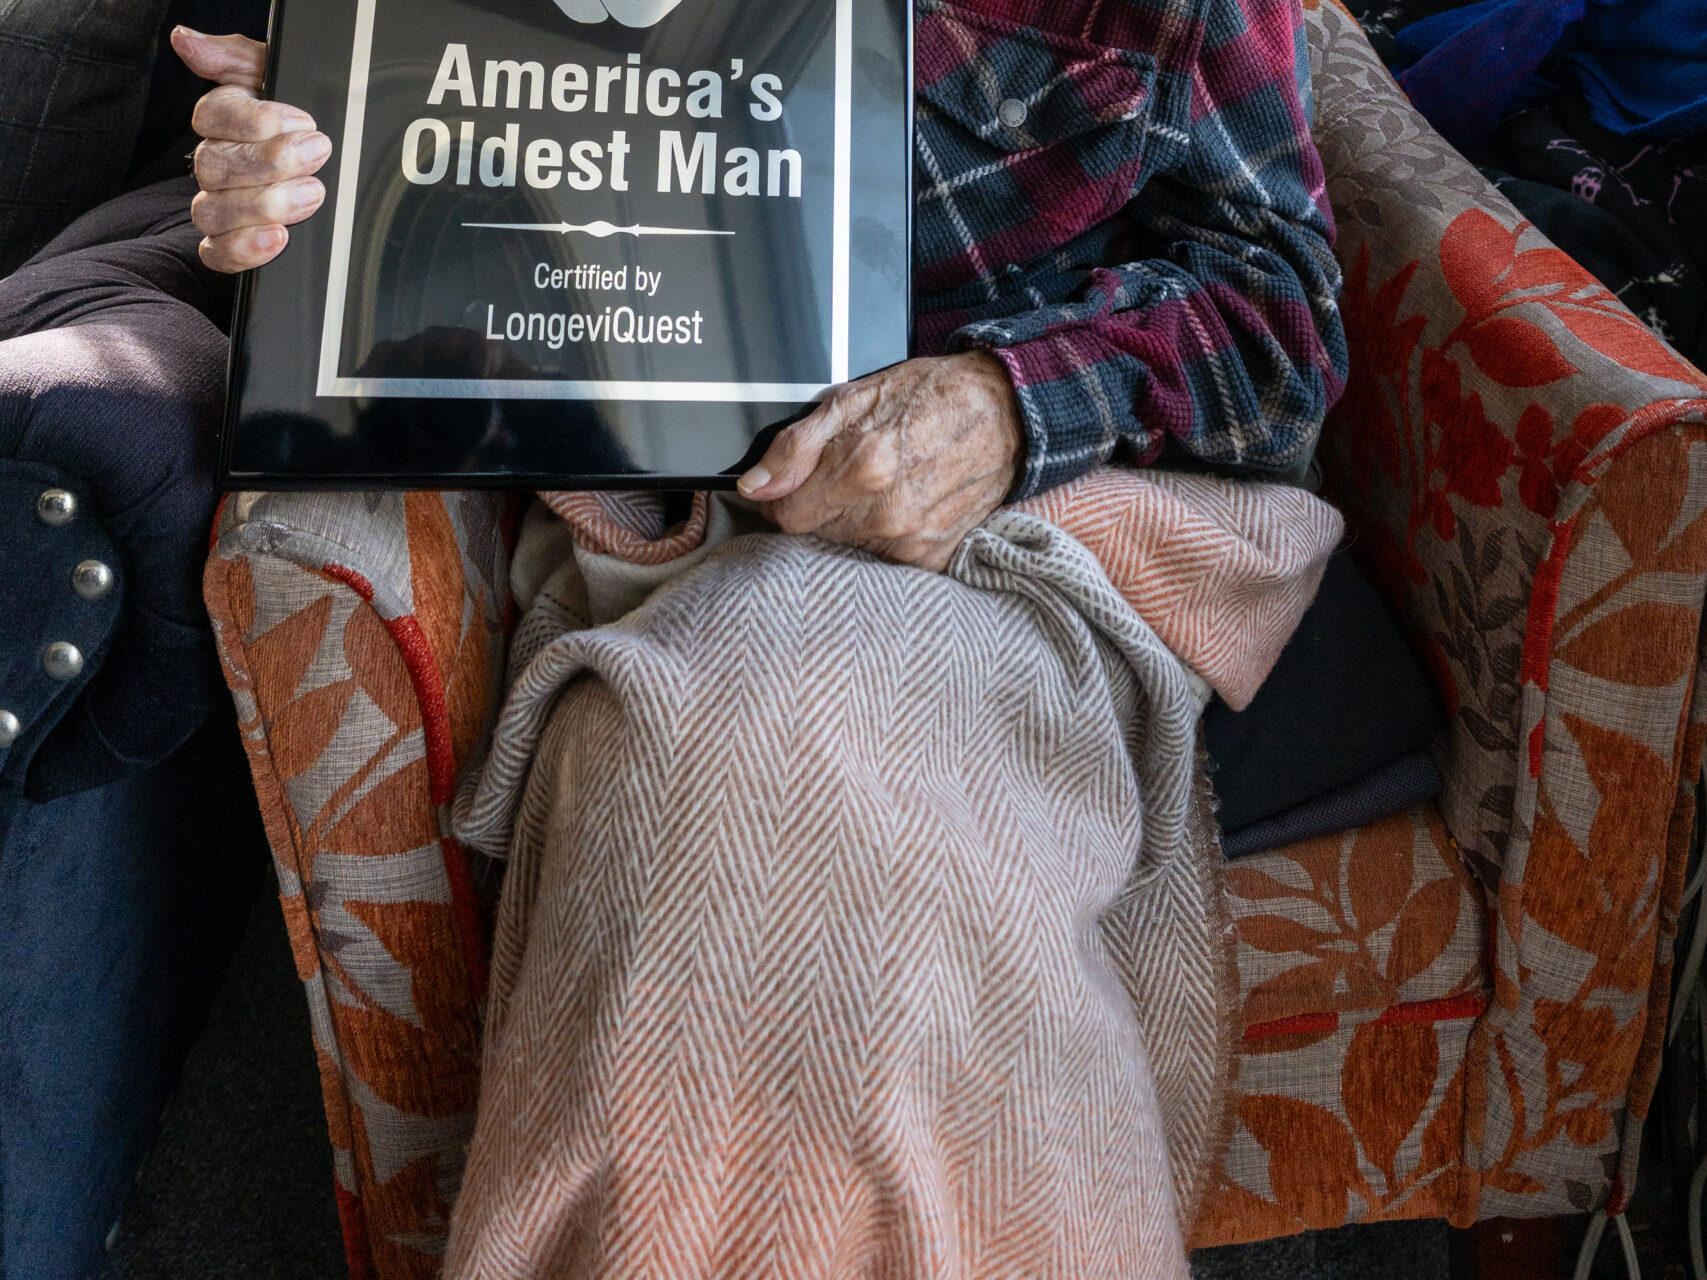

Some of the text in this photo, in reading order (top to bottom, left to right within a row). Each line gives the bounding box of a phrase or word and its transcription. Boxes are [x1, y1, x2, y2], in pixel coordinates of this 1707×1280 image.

[401, 117, 803, 198] Oldest Man
[534, 262, 662, 297] Certified by
[486, 304, 704, 350] LongeviQuest
